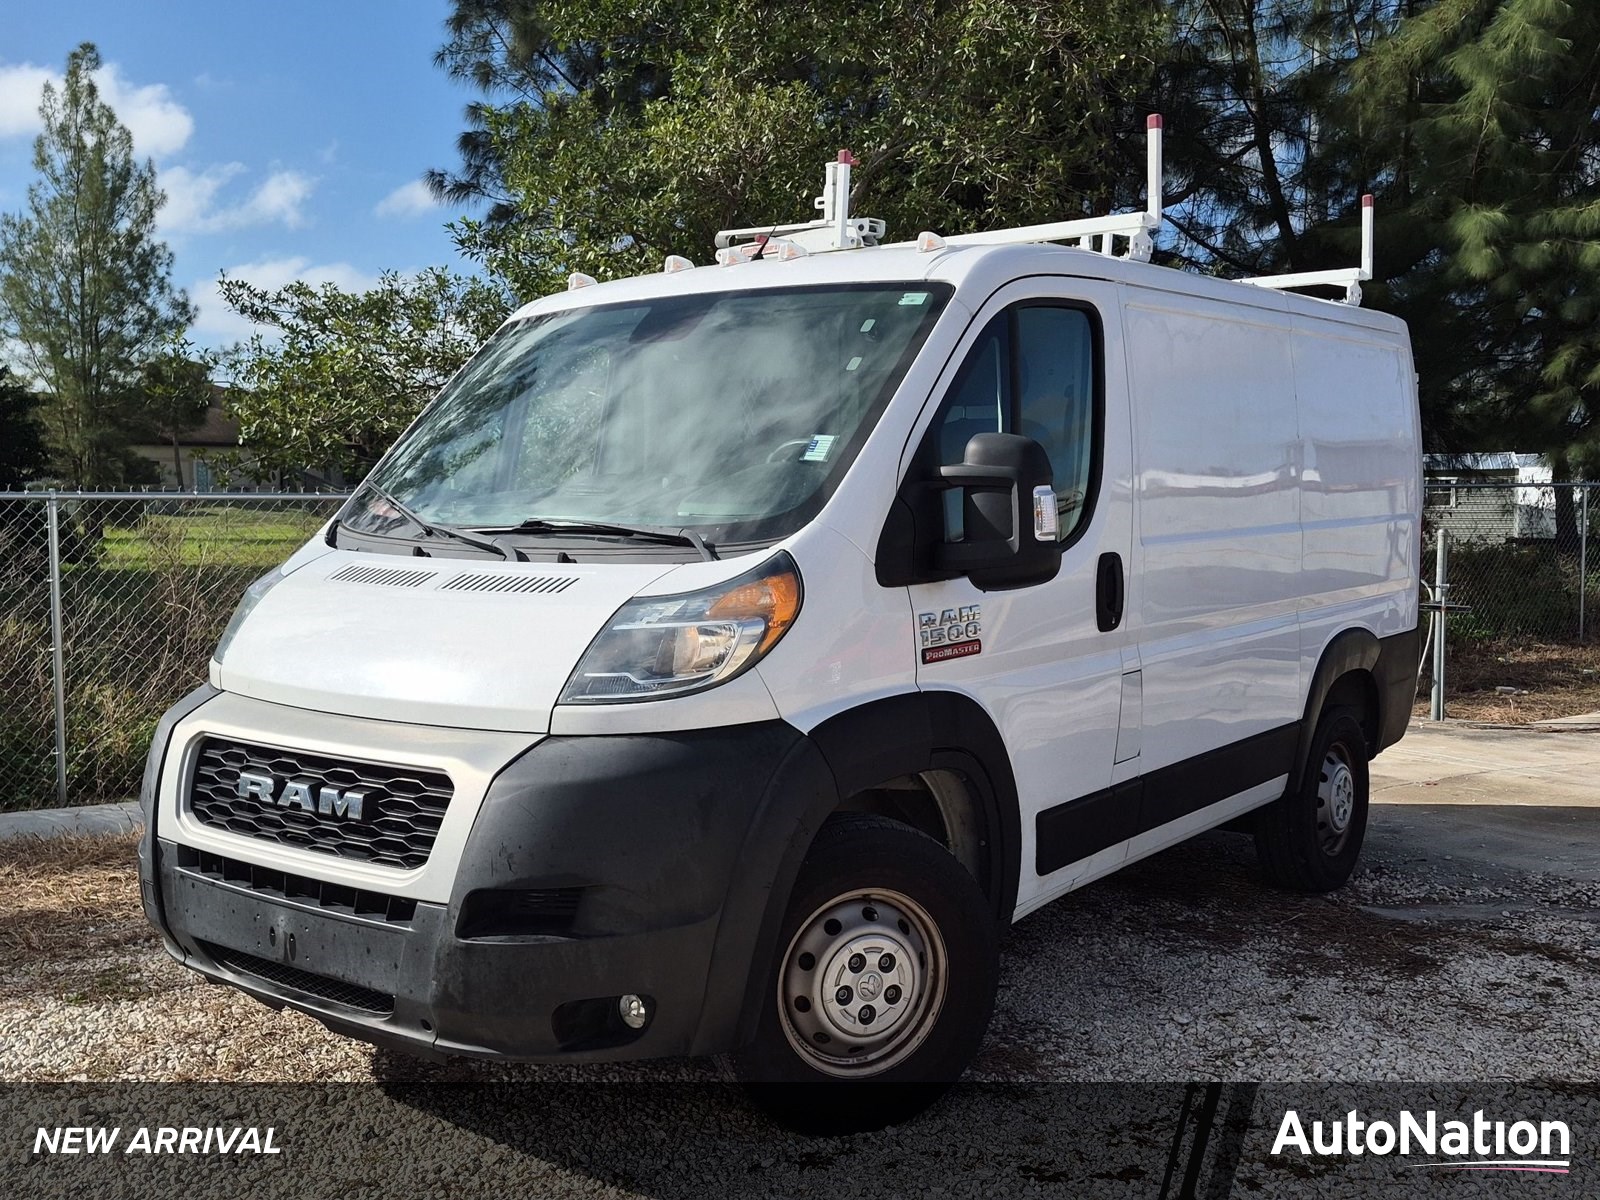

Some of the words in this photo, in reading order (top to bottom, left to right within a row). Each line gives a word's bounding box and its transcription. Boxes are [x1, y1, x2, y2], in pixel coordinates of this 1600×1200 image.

[919, 605, 980, 629] RAM
[920, 621, 981, 646] 1500
[926, 644, 979, 660] PROMASTER
[238, 771, 365, 820] RAM
